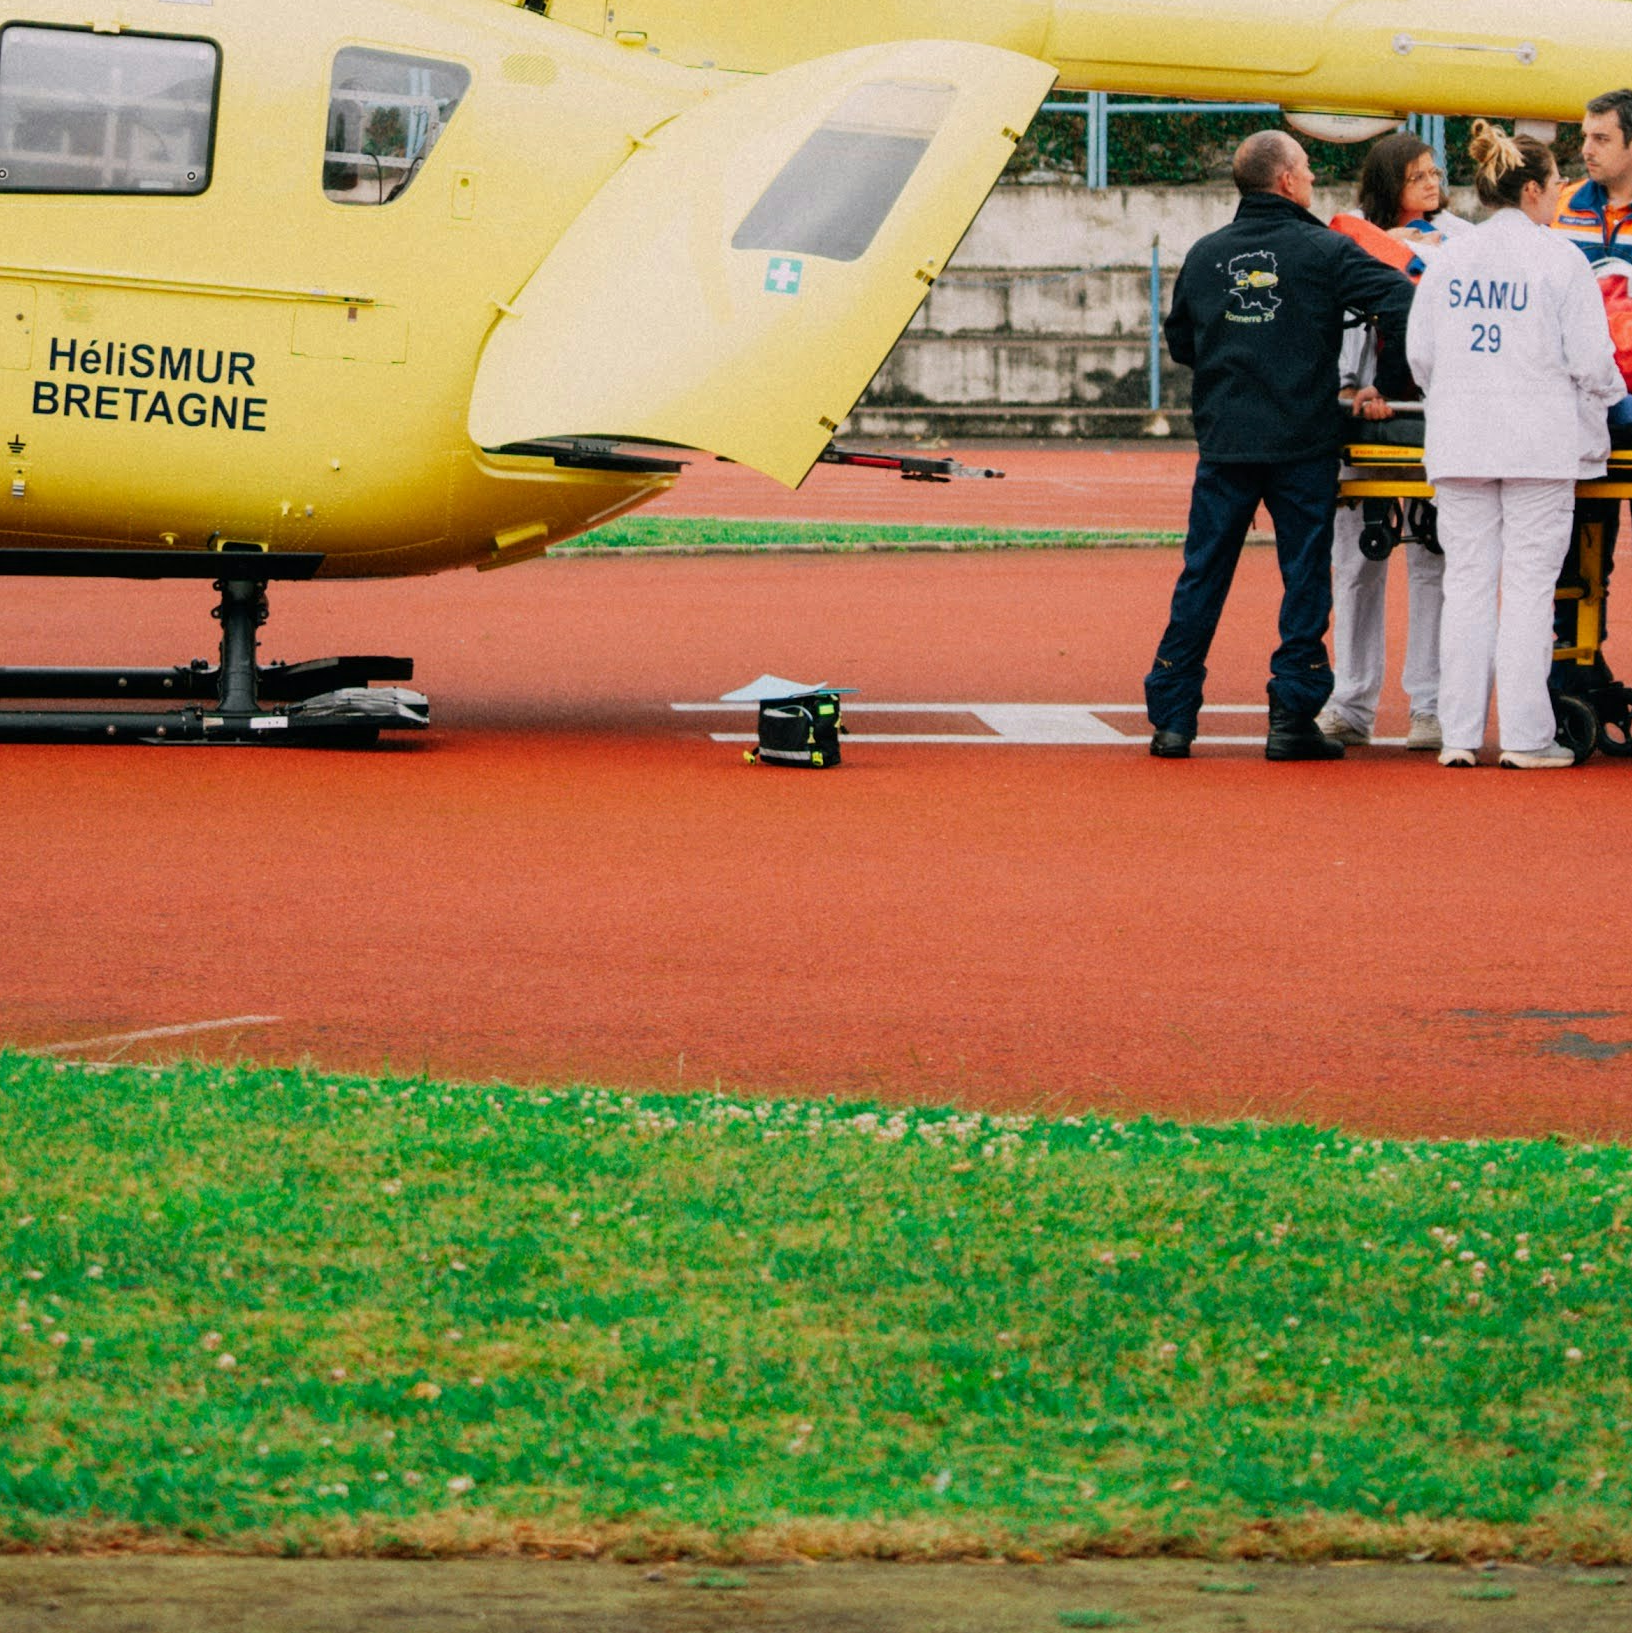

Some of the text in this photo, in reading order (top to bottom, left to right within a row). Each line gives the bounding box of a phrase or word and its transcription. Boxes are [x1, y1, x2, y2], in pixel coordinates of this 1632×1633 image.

[1448, 278, 1528, 312] SAMU
[1225, 309, 1276, 323] Tonnerre 29
[1470, 323, 1502, 354] 29
[49, 337, 256, 387] HéliSMUR
[32, 380, 268, 432] BRETAGNE
